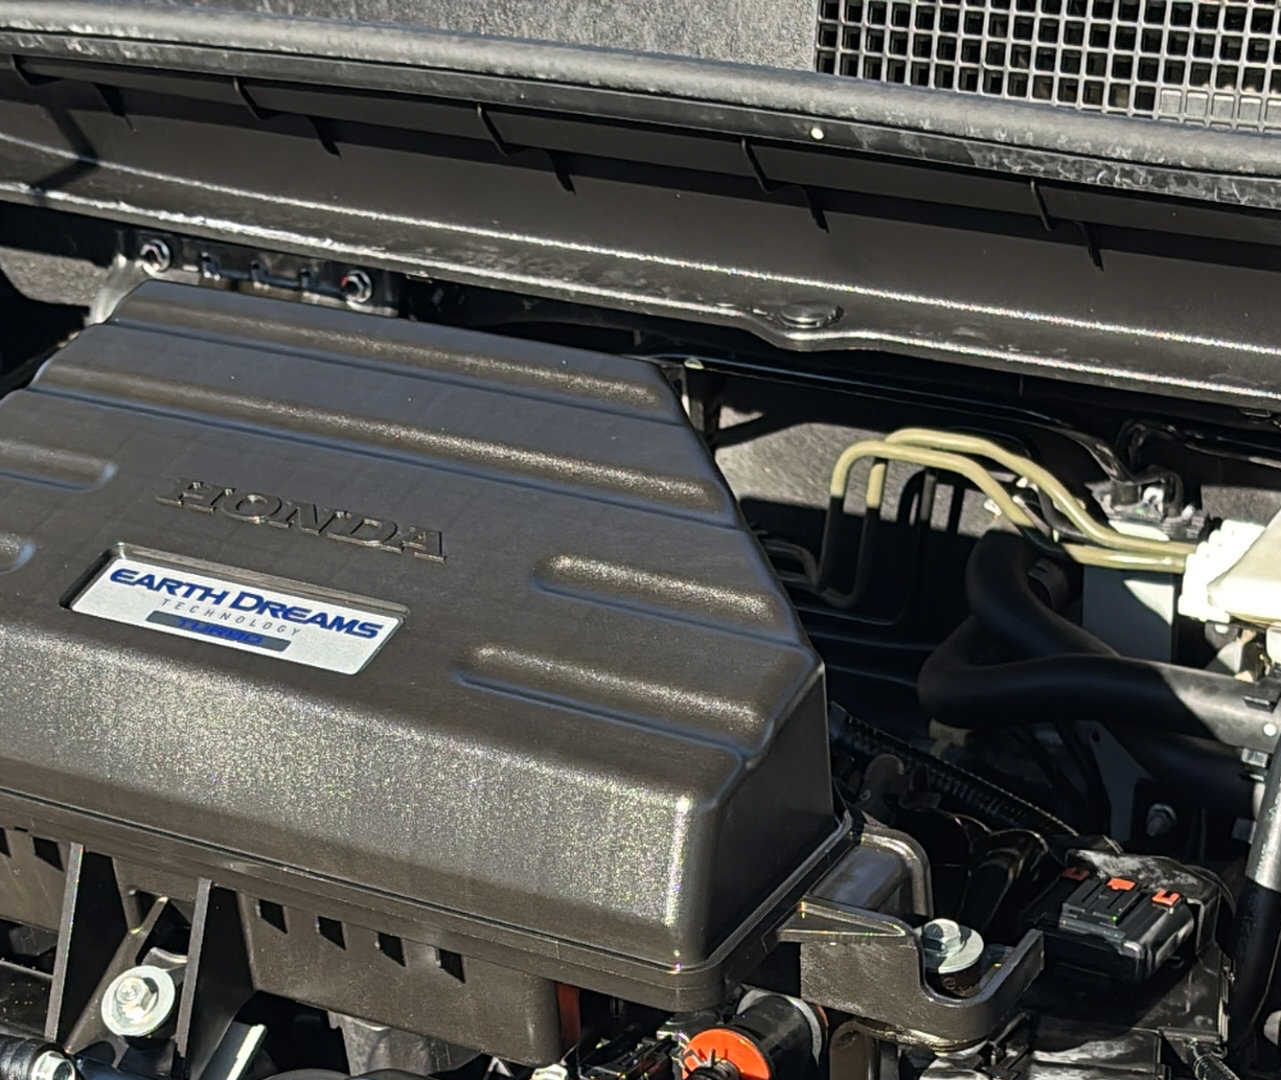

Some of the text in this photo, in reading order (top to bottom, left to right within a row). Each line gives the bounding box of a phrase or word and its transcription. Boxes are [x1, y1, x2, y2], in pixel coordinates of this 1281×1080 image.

[157, 480, 446, 560] HONDA
[110, 568, 384, 639] EARTH DREAMS
[160, 598, 302, 637] TECHNOLOGY
